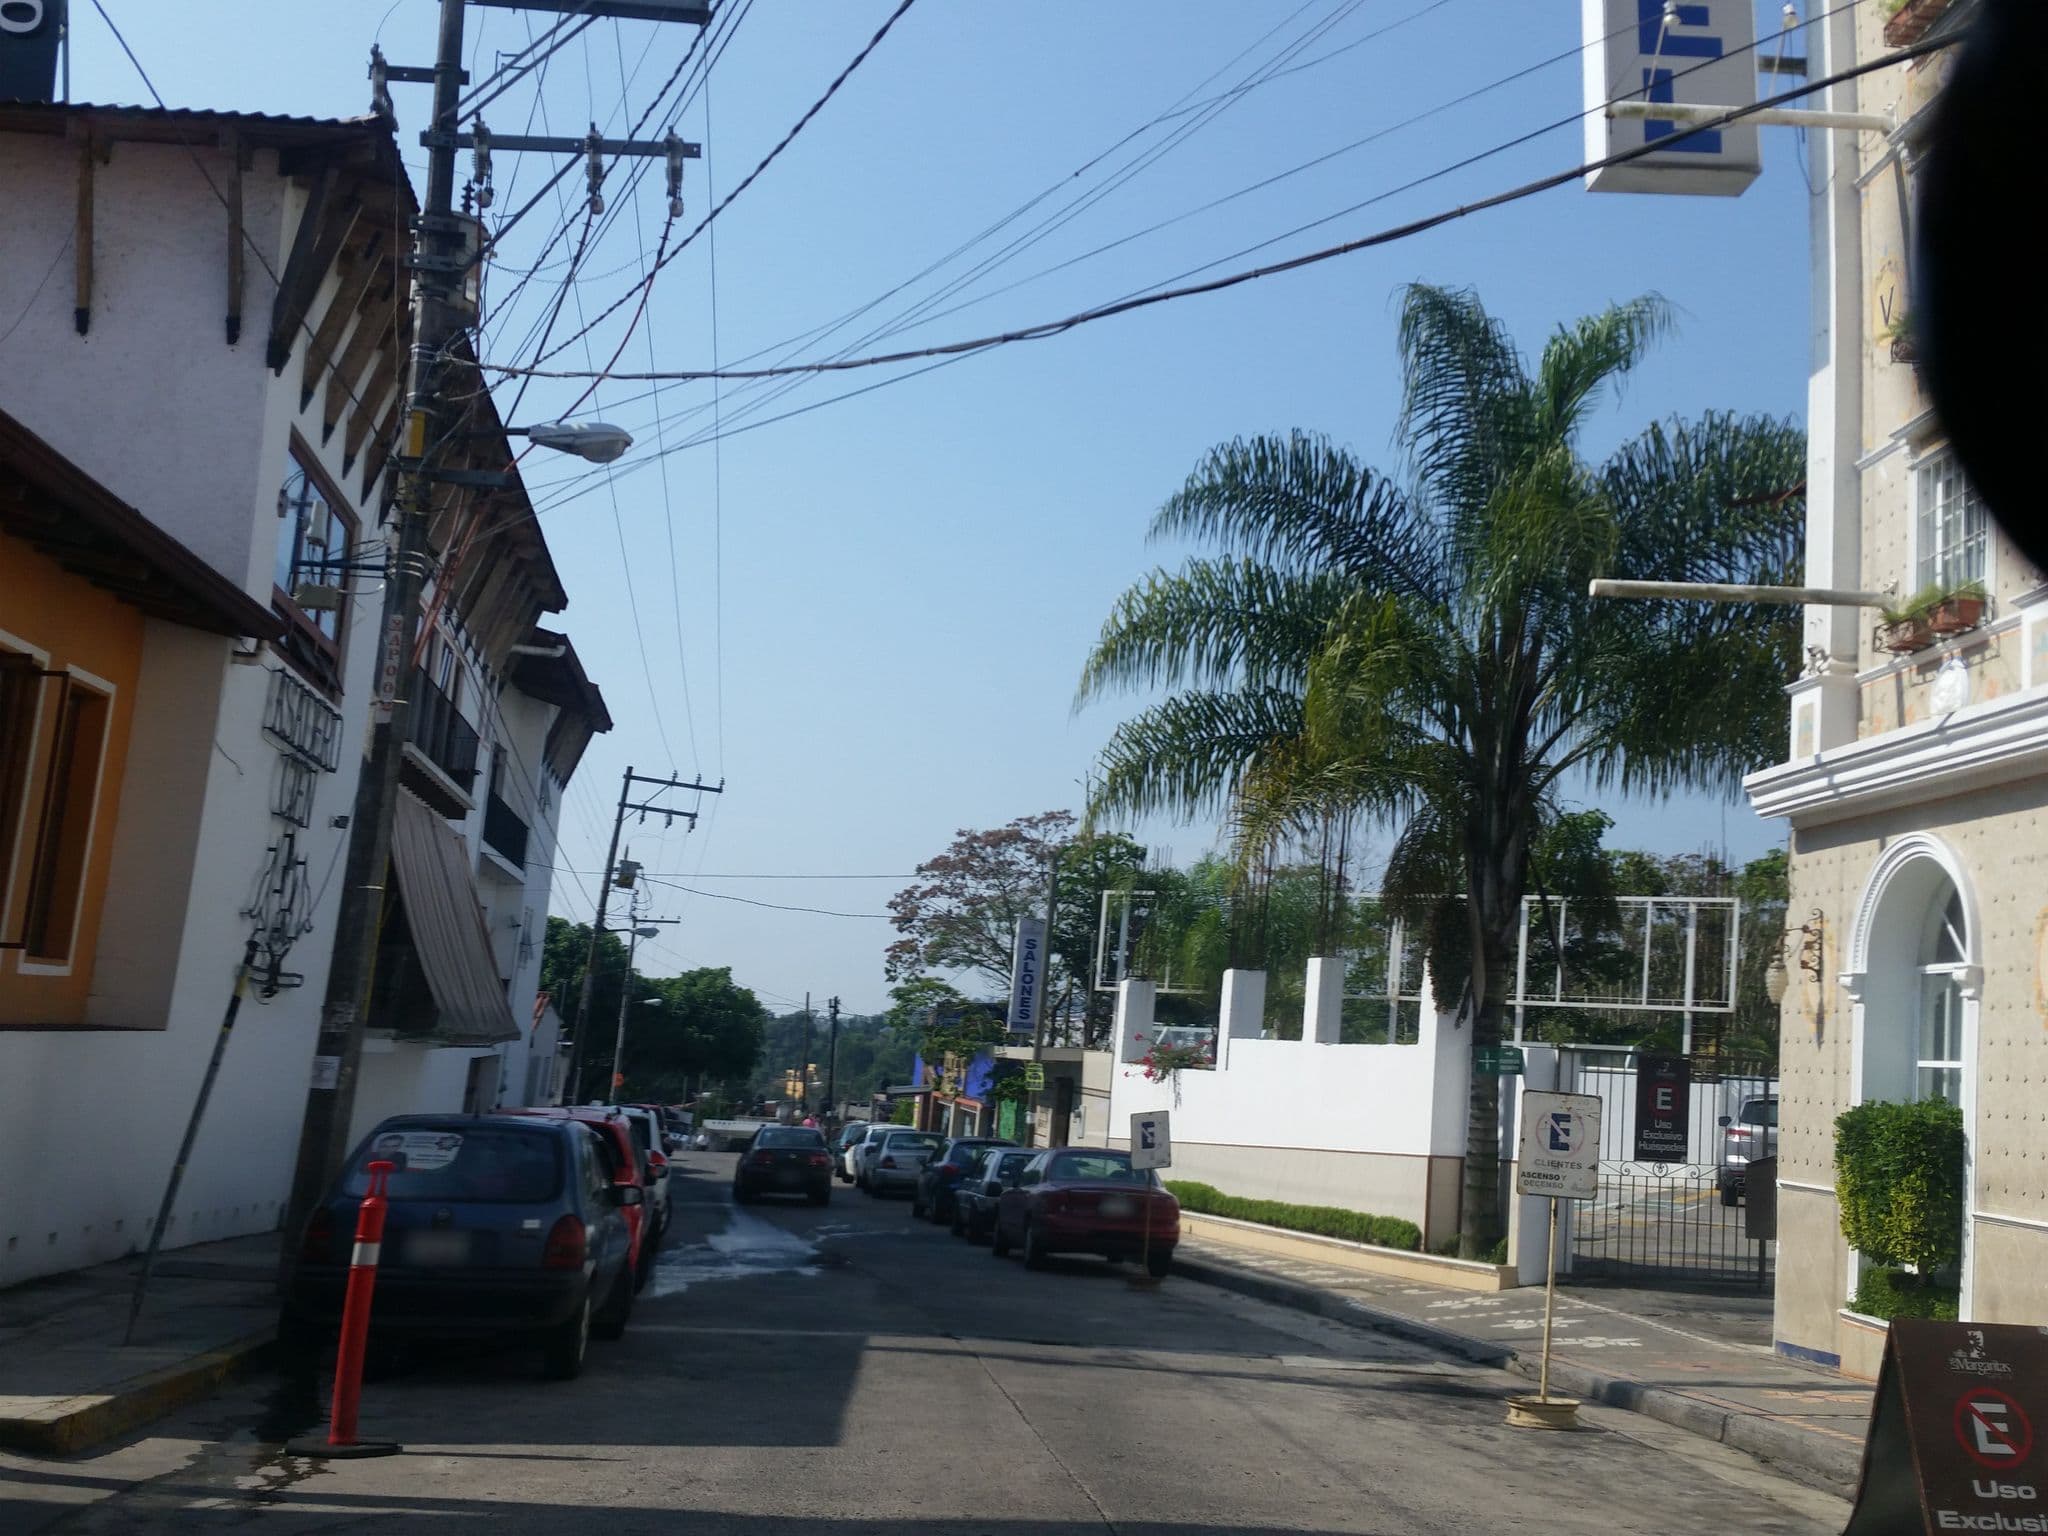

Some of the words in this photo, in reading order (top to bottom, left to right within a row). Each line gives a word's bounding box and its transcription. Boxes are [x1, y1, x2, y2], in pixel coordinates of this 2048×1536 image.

[1018, 938, 1037, 1020] SALONES
[1656, 1088, 1673, 1110] E
[1654, 1119, 1672, 1129] Uso
[1643, 1130, 1682, 1141] Exclusivo
[1534, 1158, 1583, 1170] CLIENTES
[1521, 1171, 1560, 1181] ASCENSO
[1523, 1179, 1564, 1189] DECENSO
[1968, 1402, 2017, 1454] E
[1974, 1480, 2037, 1500] Uso
[1937, 1510, 2048, 1533] Exclusi
